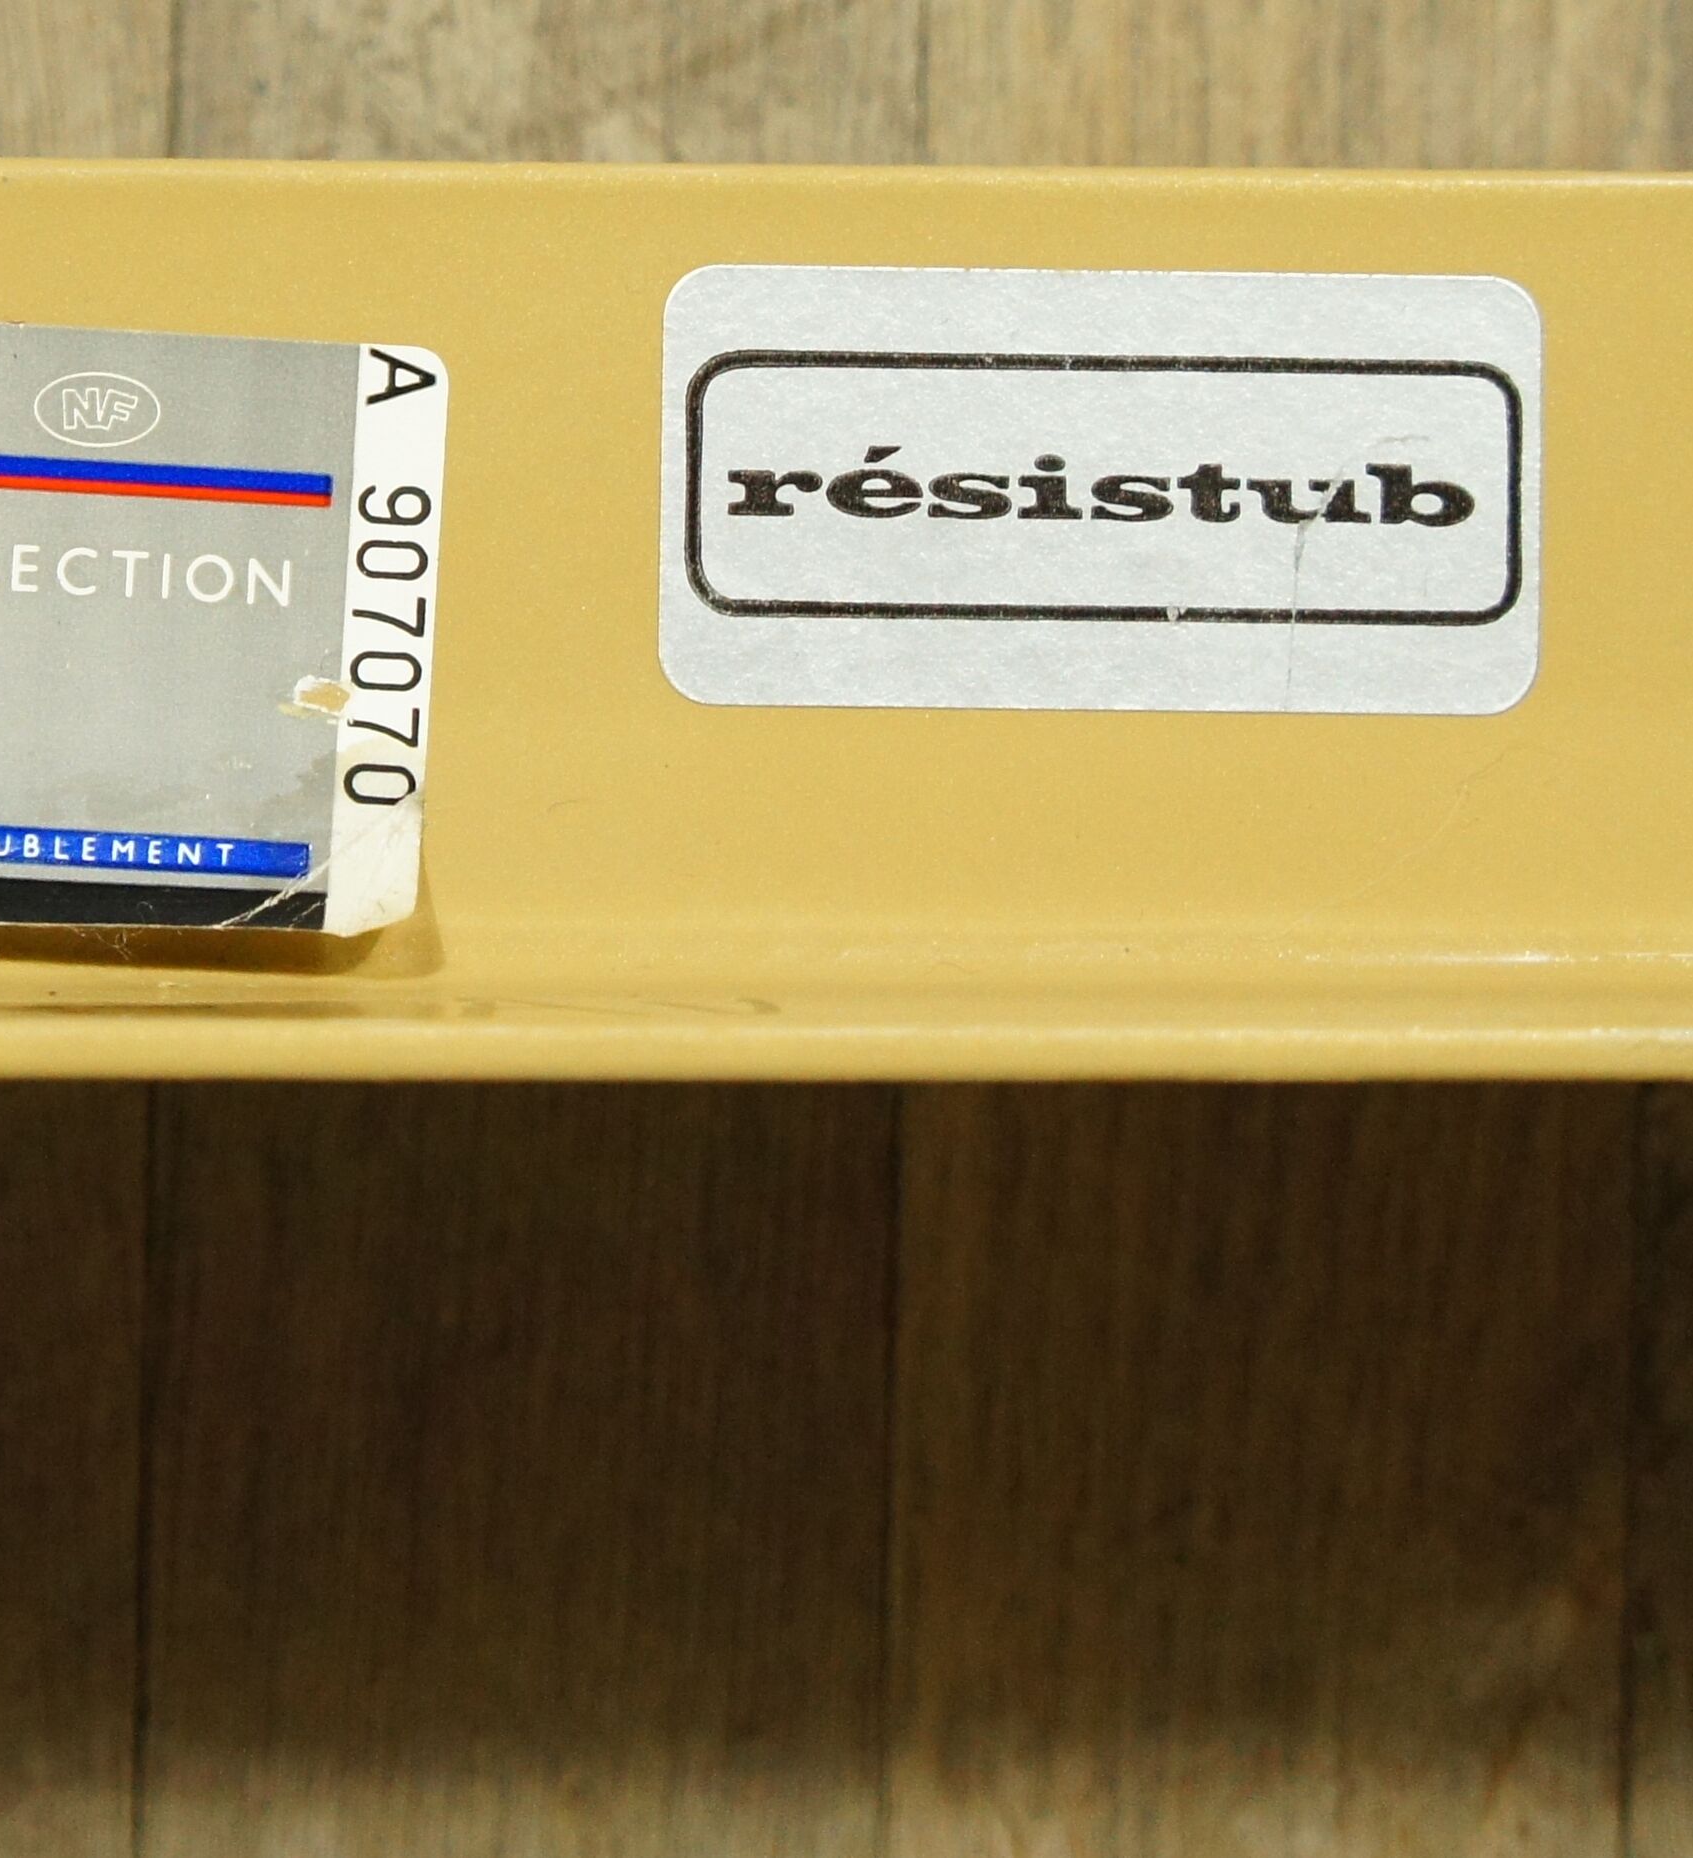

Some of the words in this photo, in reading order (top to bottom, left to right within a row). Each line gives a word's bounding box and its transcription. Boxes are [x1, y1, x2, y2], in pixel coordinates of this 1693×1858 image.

[62, 387, 138, 430] NF
[366, 348, 436, 406] A
[727, 445, 1476, 528] résistub
[343, 484, 432, 807] 907070
